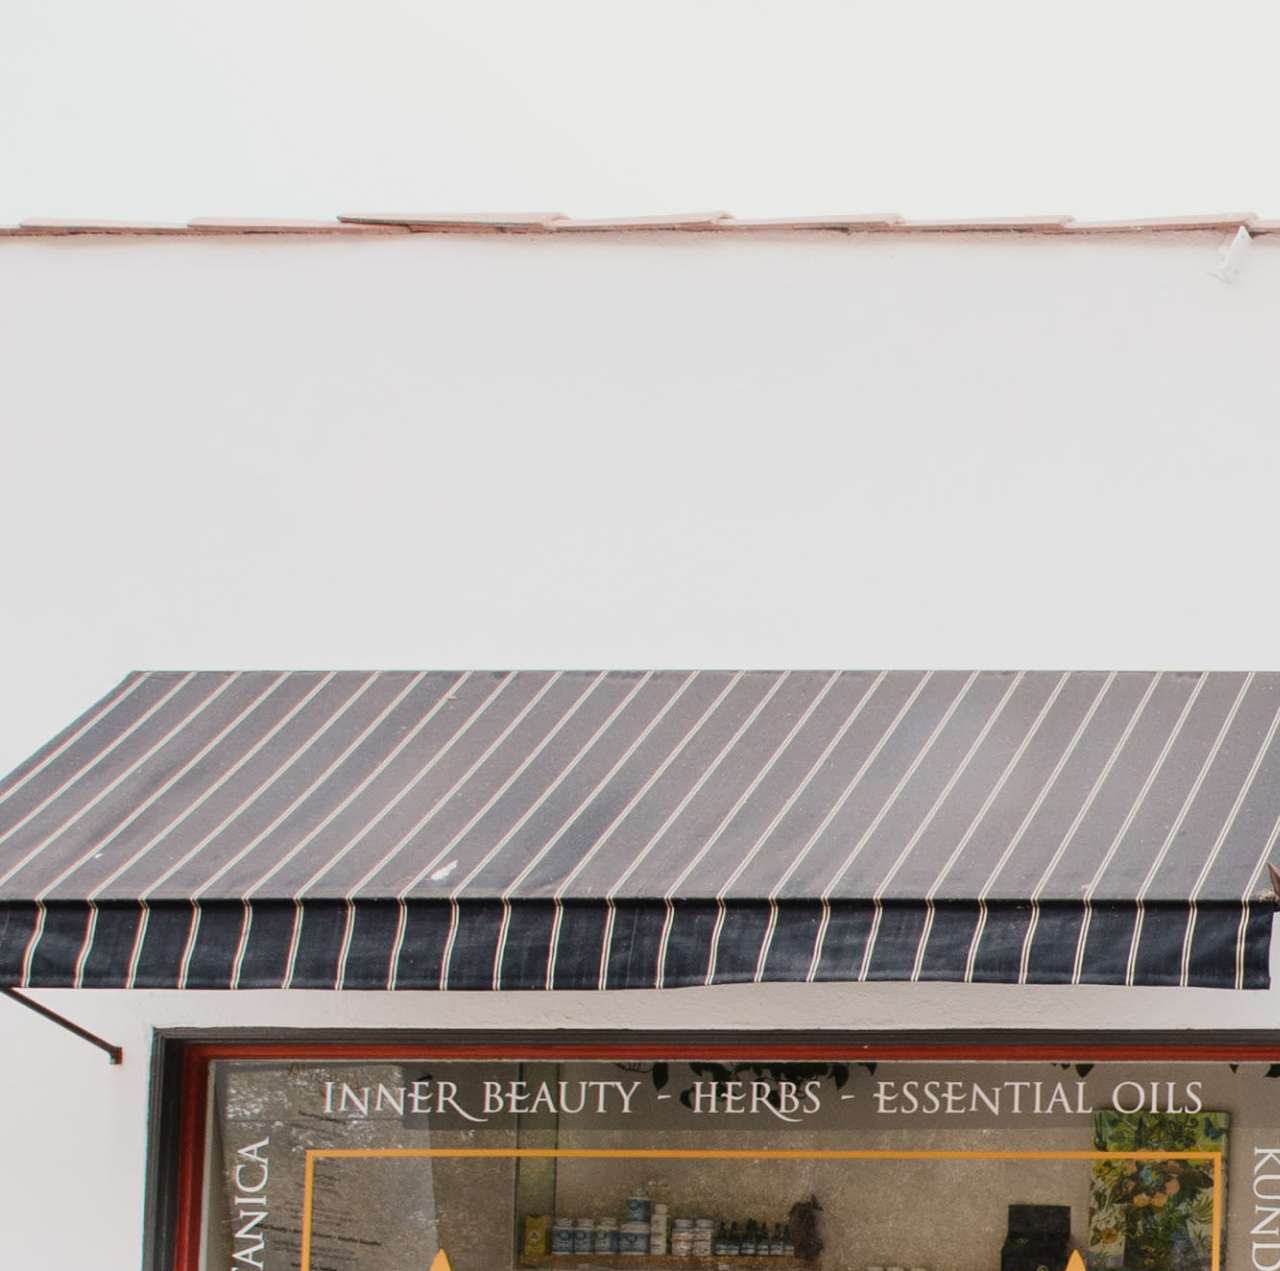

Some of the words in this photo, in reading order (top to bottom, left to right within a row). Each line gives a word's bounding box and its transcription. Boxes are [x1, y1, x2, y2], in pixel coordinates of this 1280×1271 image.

[323, 1081, 489, 1123] INNER
[482, 1081, 643, 1115] BEAUTY
[692, 1081, 823, 1123] HERBS
[872, 1081, 1093, 1116] ESSENTIAL
[1111, 1081, 1204, 1116] OILS
